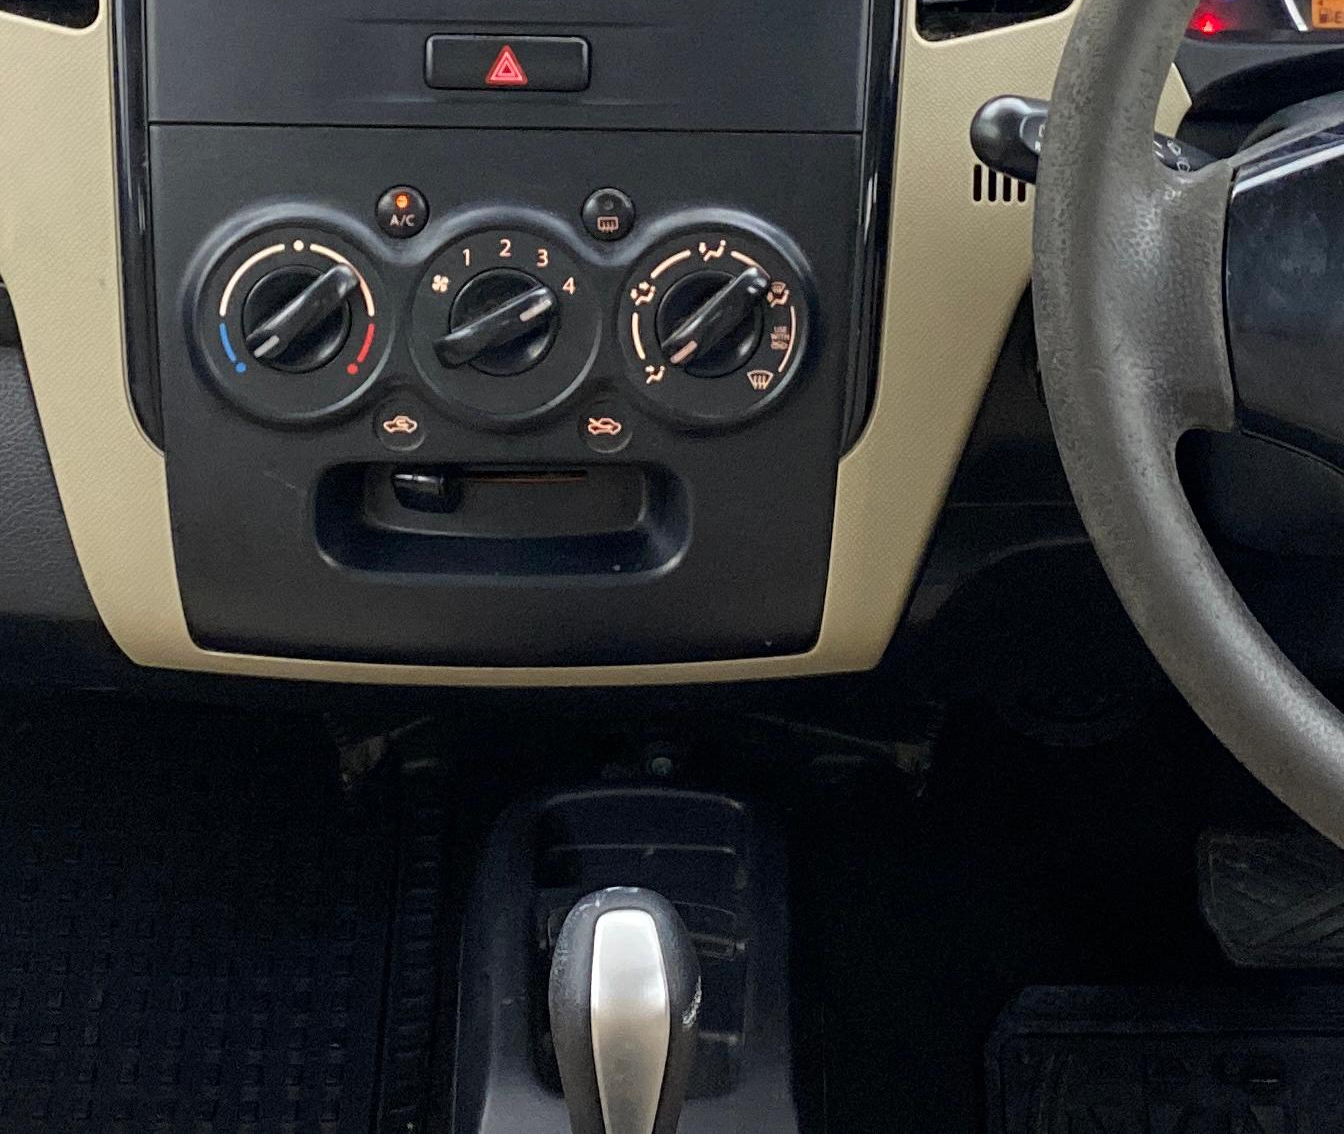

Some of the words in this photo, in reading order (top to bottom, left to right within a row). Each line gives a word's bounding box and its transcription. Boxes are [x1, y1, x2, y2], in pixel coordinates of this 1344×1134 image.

[389, 215, 415, 227] A/C
[462, 248, 471, 266] 1
[499, 239, 511, 257] 2
[536, 249, 549, 267] 3
[562, 277, 577, 295] 4
